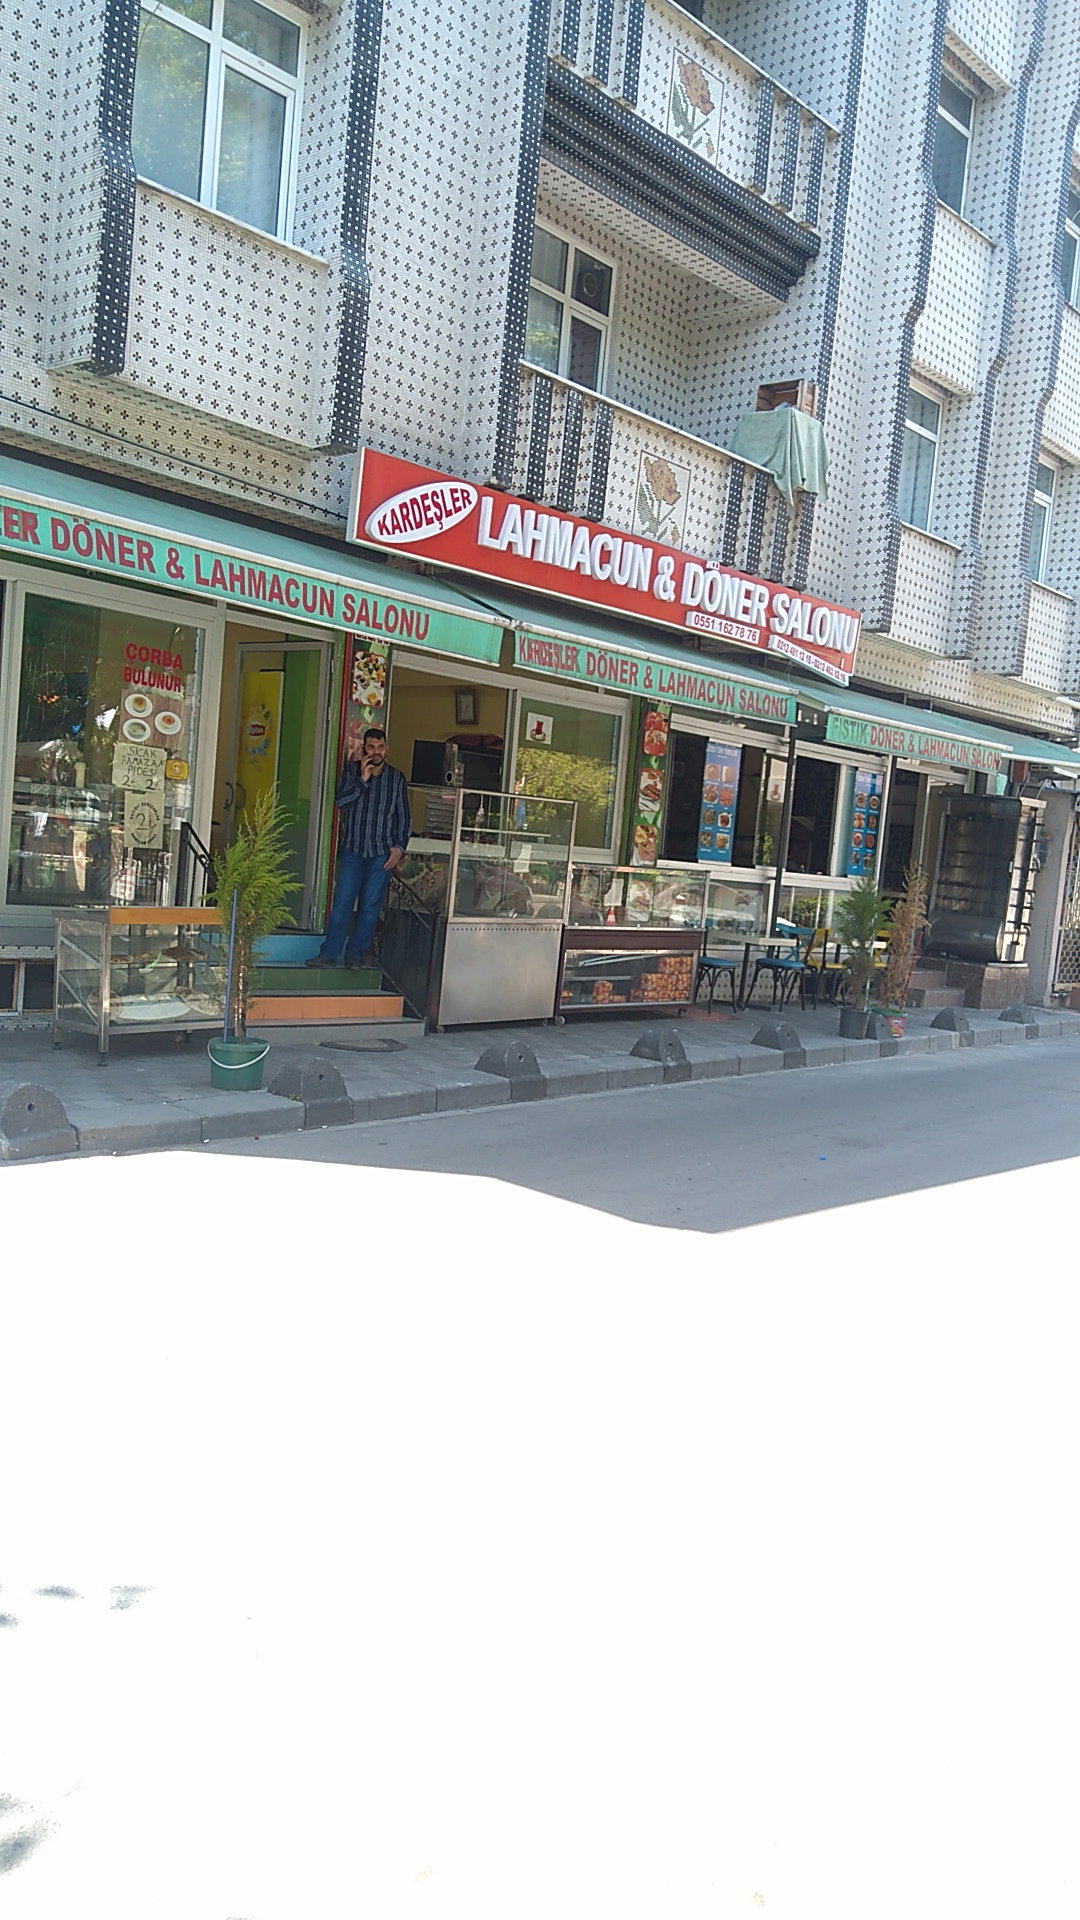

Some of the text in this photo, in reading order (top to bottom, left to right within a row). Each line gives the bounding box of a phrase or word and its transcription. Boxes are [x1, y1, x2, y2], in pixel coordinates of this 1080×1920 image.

[377, 487, 473, 536] KARDEŞLER
[0, 506, 430, 642] ER DÖNER & LAHMACUN SALONU
[477, 496, 860, 654] LAHMACUN & DÖNER SALONU
[694, 614, 757, 642] 0551 162 78 76
[776, 639, 790, 653] 0212
[125, 643, 183, 670] ÇORBA
[123, 667, 181, 692] BULUNUR
[586, 650, 638, 688] DÖNER
[643, 665, 653, 689] &
[657, 668, 735, 707] LAHMACUN
[738, 687, 788, 718] SALONU
[869, 724, 904, 752] DÖNER
[907, 734, 915, 753] &
[917, 735, 969, 765] LAHMACUN
